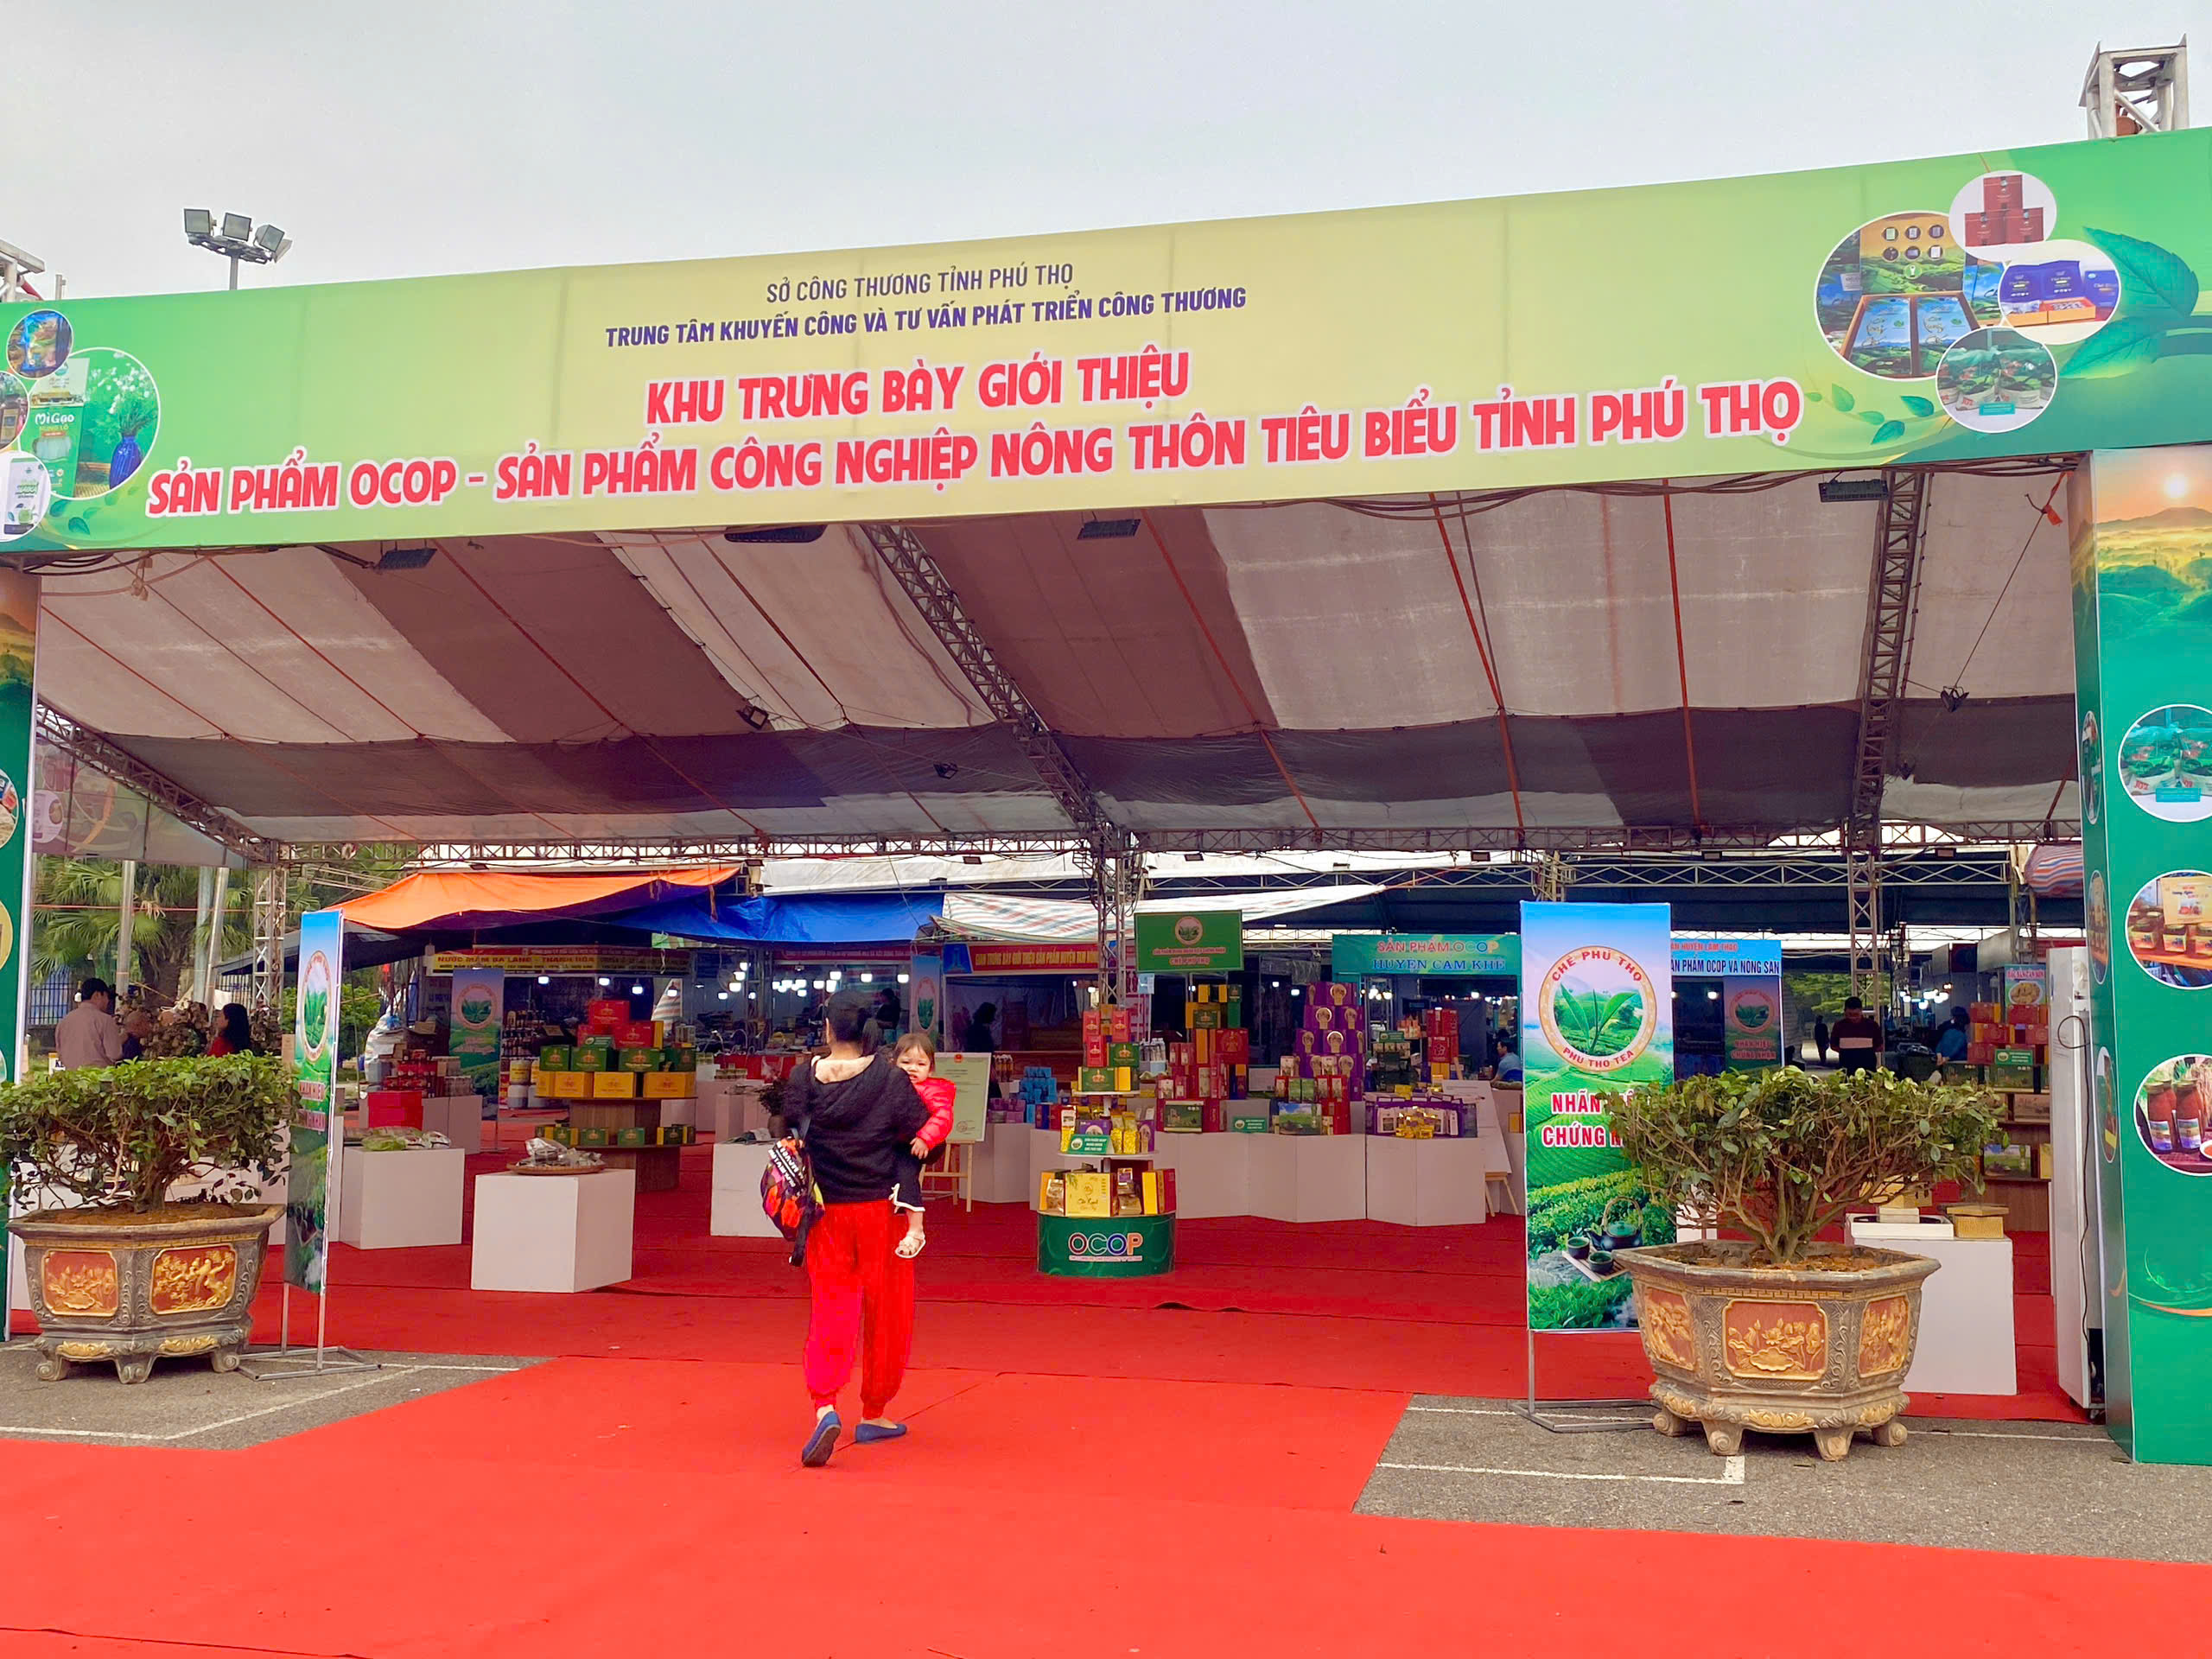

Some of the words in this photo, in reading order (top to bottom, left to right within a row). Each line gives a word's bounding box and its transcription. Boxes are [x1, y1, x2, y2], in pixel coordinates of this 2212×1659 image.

[767, 275, 790, 303] SỞ
[798, 278, 847, 302] CÔNG
[854, 273, 931, 297] THƯƠNG
[939, 268, 982, 291] TỈNH
[990, 263, 1027, 289] PHÚ
[1036, 264, 1073, 289] THỌ
[606, 325, 670, 347] TRUNG
[677, 319, 715, 343] TÂM
[720, 311, 798, 341] KHUYẾN
[804, 310, 857, 336] CÔNG
[864, 309, 887, 333] VÀ
[895, 308, 923, 331] TƯ
[928, 302, 966, 328] VẤN
[973, 302, 1026, 326] PHÁT
[1032, 290, 1092, 322] TRIỂN
[1099, 291, 1154, 318] CÔNG
[1160, 287, 1246, 313] THƯƠNG
[647, 380, 723, 424] KHU
[739, 372, 868, 420] TRƯNG
[882, 359, 963, 413] BÀY
[979, 352, 1062, 408] GIỚI
[1077, 345, 1188, 408] THIỆU
[150, 461, 219, 514] SẢN
[231, 445, 338, 511] PHẨM
[351, 461, 456, 505] OCOP
[497, 443, 570, 499] SẢN
[583, 431, 696, 495] PHẨM
[711, 436, 822, 490] CÔNG
[836, 428, 977, 492] NGHIỆP
[991, 422, 1113, 478] NÔNG
[1128, 412, 1245, 470] THÔN
[1262, 406, 1349, 463] TIÊU
[1364, 387, 1457, 457] BIỂU
[1474, 388, 1575, 449] TỈNH
[1592, 379, 1684, 442] PHÚ
[1701, 381, 1800, 442] THỌ
[1377, 937, 1405, 952] SẢN
[1409, 937, 1449, 952] PHẨM
[1453, 940, 1499, 954] OCOP
[1552, 954, 1577, 982] CHÈ
[1581, 950, 1611, 961] PHÚ
[1707, 959, 1726, 973] OCOP
[1562, 1046, 1585, 1065] PHU
[1588, 1058, 1611, 1068] THO
[1614, 1050, 1635, 1065] TEA
[1552, 1090, 1600, 1113] NHÃN
[1542, 1122, 1605, 1146] CHỨNG
[1068, 1232, 1144, 1255] OCOP
